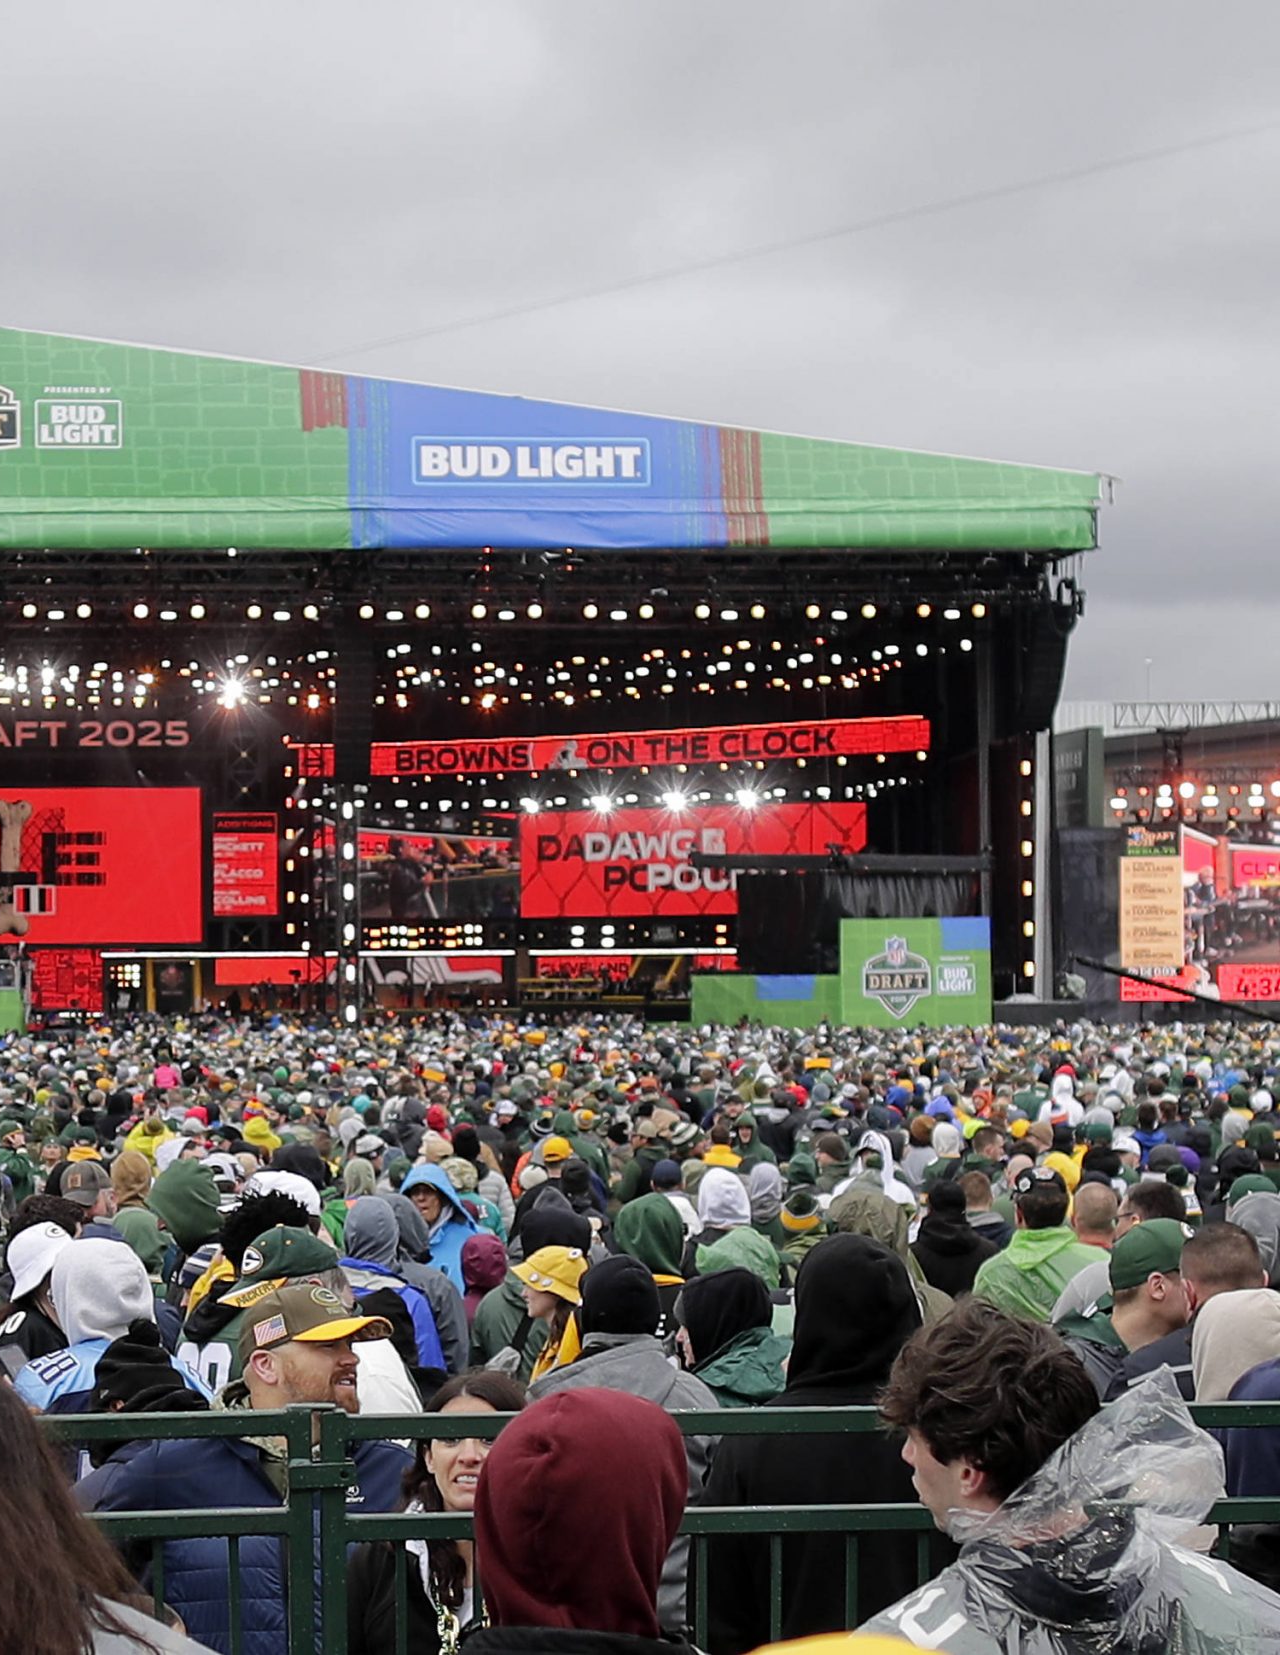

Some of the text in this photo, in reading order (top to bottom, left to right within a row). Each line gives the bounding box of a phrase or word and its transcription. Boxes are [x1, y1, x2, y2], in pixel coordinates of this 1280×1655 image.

[51, 405, 106, 424] BUD
[40, 424, 116, 443] LIGHT
[420, 445, 641, 477] BUD LIGHT
[79, 720, 190, 747] 2025
[394, 727, 837, 772] BROWNS ON THE CLOCK
[869, 975, 924, 989] DRAFT
[943, 967, 968, 979] BUD
[940, 980, 973, 992] LIGHT
